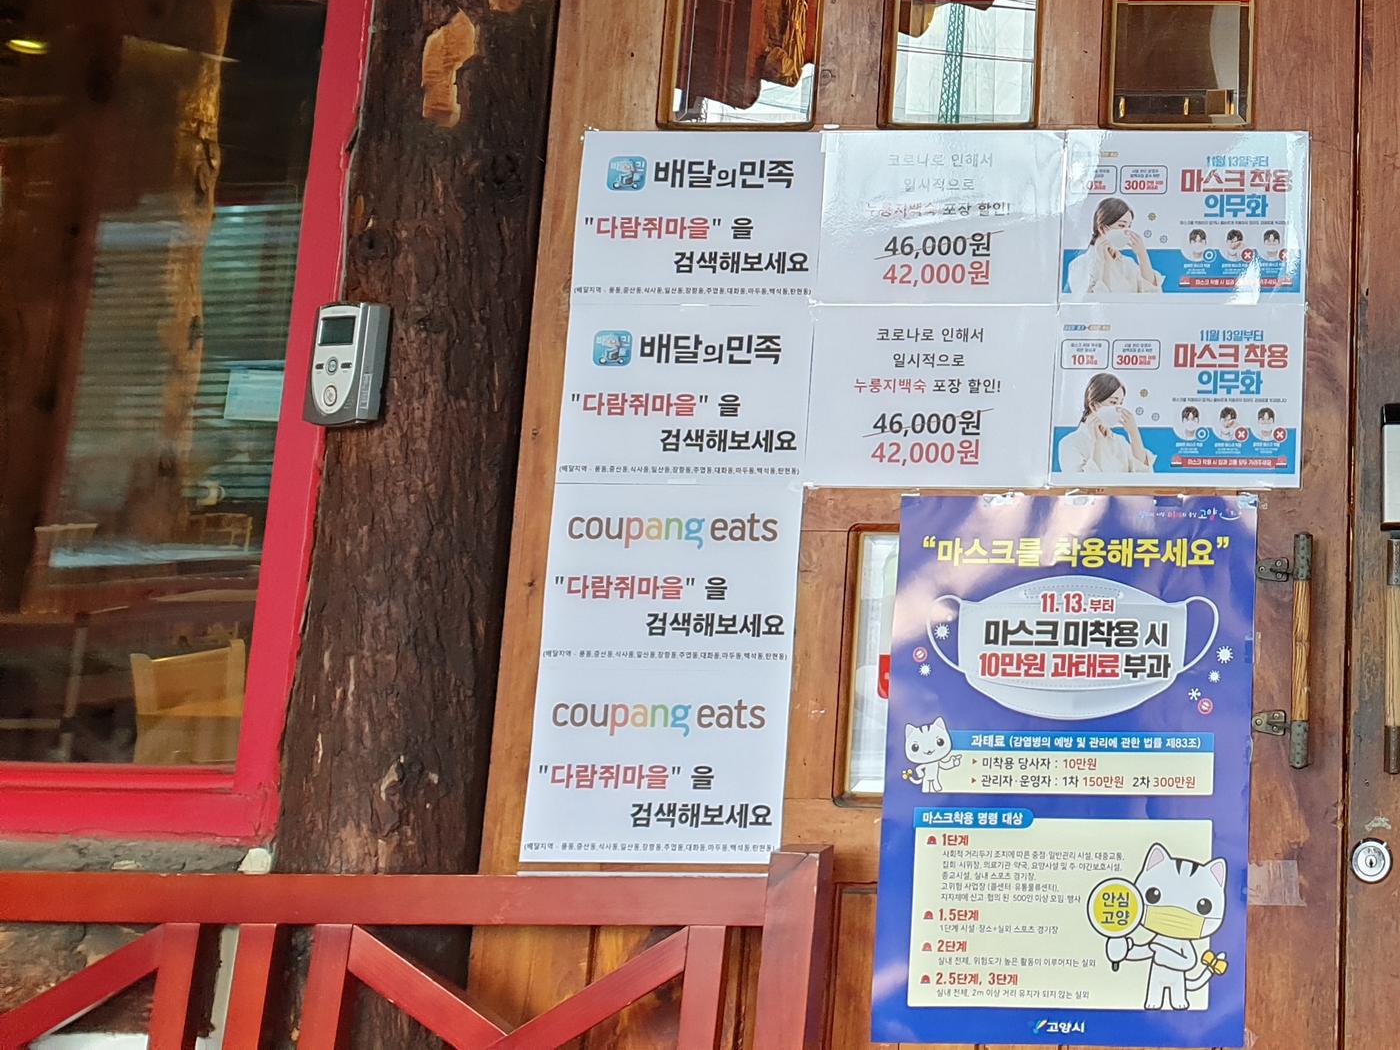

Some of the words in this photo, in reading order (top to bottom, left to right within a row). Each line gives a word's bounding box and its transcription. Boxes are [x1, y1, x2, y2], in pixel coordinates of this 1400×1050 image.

[653, 158, 795, 190] 배달의민족
[1180, 168, 1247, 194] 마스크
[1203, 192, 1269, 219] 의무화
[584, 216, 722, 240] "다람쥐마을"
[730, 217, 755, 240] 을
[673, 250, 810, 275] 검색해보세요
[882, 260, 992, 287] 42,000원
[876, 328, 935, 343] 코로나로
[941, 328, 984, 343] 인해서
[1199, 329, 1221, 342] 11월
[639, 333, 783, 365] 배달의민족
[893, 353, 966, 369] 일시적으로
[1173, 343, 1240, 369] 마스크
[1244, 343, 1289, 369] 착용
[853, 378, 927, 394] 누룽지백숙
[932, 378, 962, 394] 포장
[967, 378, 1002, 394] 할인!
[1196, 368, 1264, 396] 의무화
[571, 393, 709, 417] "다람쥐마을"
[718, 393, 741, 418] 을
[872, 410, 982, 436] 46,000원
[659, 428, 798, 453] 검색해보세요
[871, 439, 981, 466] 42,000원
[567, 516, 705, 550] coupang
[709, 513, 779, 543] eats
[922, 535, 1043, 567] “마스크를
[1054, 535, 1230, 568] 착용해주세요”
[554, 575, 695, 600] "다람쥐마을"
[704, 575, 729, 601] 을
[645, 612, 785, 638] 검색해보세요
[984, 619, 1060, 648] 마스크
[1062, 620, 1140, 648] 미착용
[1143, 621, 1169, 648] 시
[978, 652, 1046, 679] 10만원
[1051, 653, 1121, 680] 과태료
[1123, 653, 1172, 680] 부과
[551, 701, 692, 737] coupang
[696, 697, 766, 730] eats
[970, 735, 1006, 748] 과태료
[1009, 735, 1052, 749] (감염병의
[1053, 737, 1074, 749] 예방
[1076, 737, 1086, 749] 및
[1088, 737, 1119, 749] 관리에
[1120, 737, 1141, 749] 관한
[1165, 737, 1202, 750] 제83조)
[538, 763, 681, 789] "다람쥐마을"
[690, 764, 715, 790] 을
[982, 757, 1015, 770] 미착용
[1018, 758, 1052, 771] 당사자
[1062, 758, 1098, 771] 10만원
[1062, 776, 1080, 789] 1차
[1082, 776, 1126, 789] 150만원
[1132, 776, 1151, 790] 2차
[1152, 777, 1197, 790] 300만원
[630, 801, 773, 829] 검색해보세요
[922, 811, 975, 826] 마스크착용
[977, 812, 1000, 826] 명령
[1002, 812, 1024, 827] 대상
[941, 833, 970, 847] 1단계
[1101, 891, 1131, 908] 안심
[938, 909, 979, 922] 1.5단계
[1100, 910, 1131, 927] 고양
[937, 940, 968, 953] 2단계
[935, 971, 984, 987] 2.5단계,
[987, 972, 1019, 986] 3단계
[1045, 1021, 1086, 1035] 고양시
